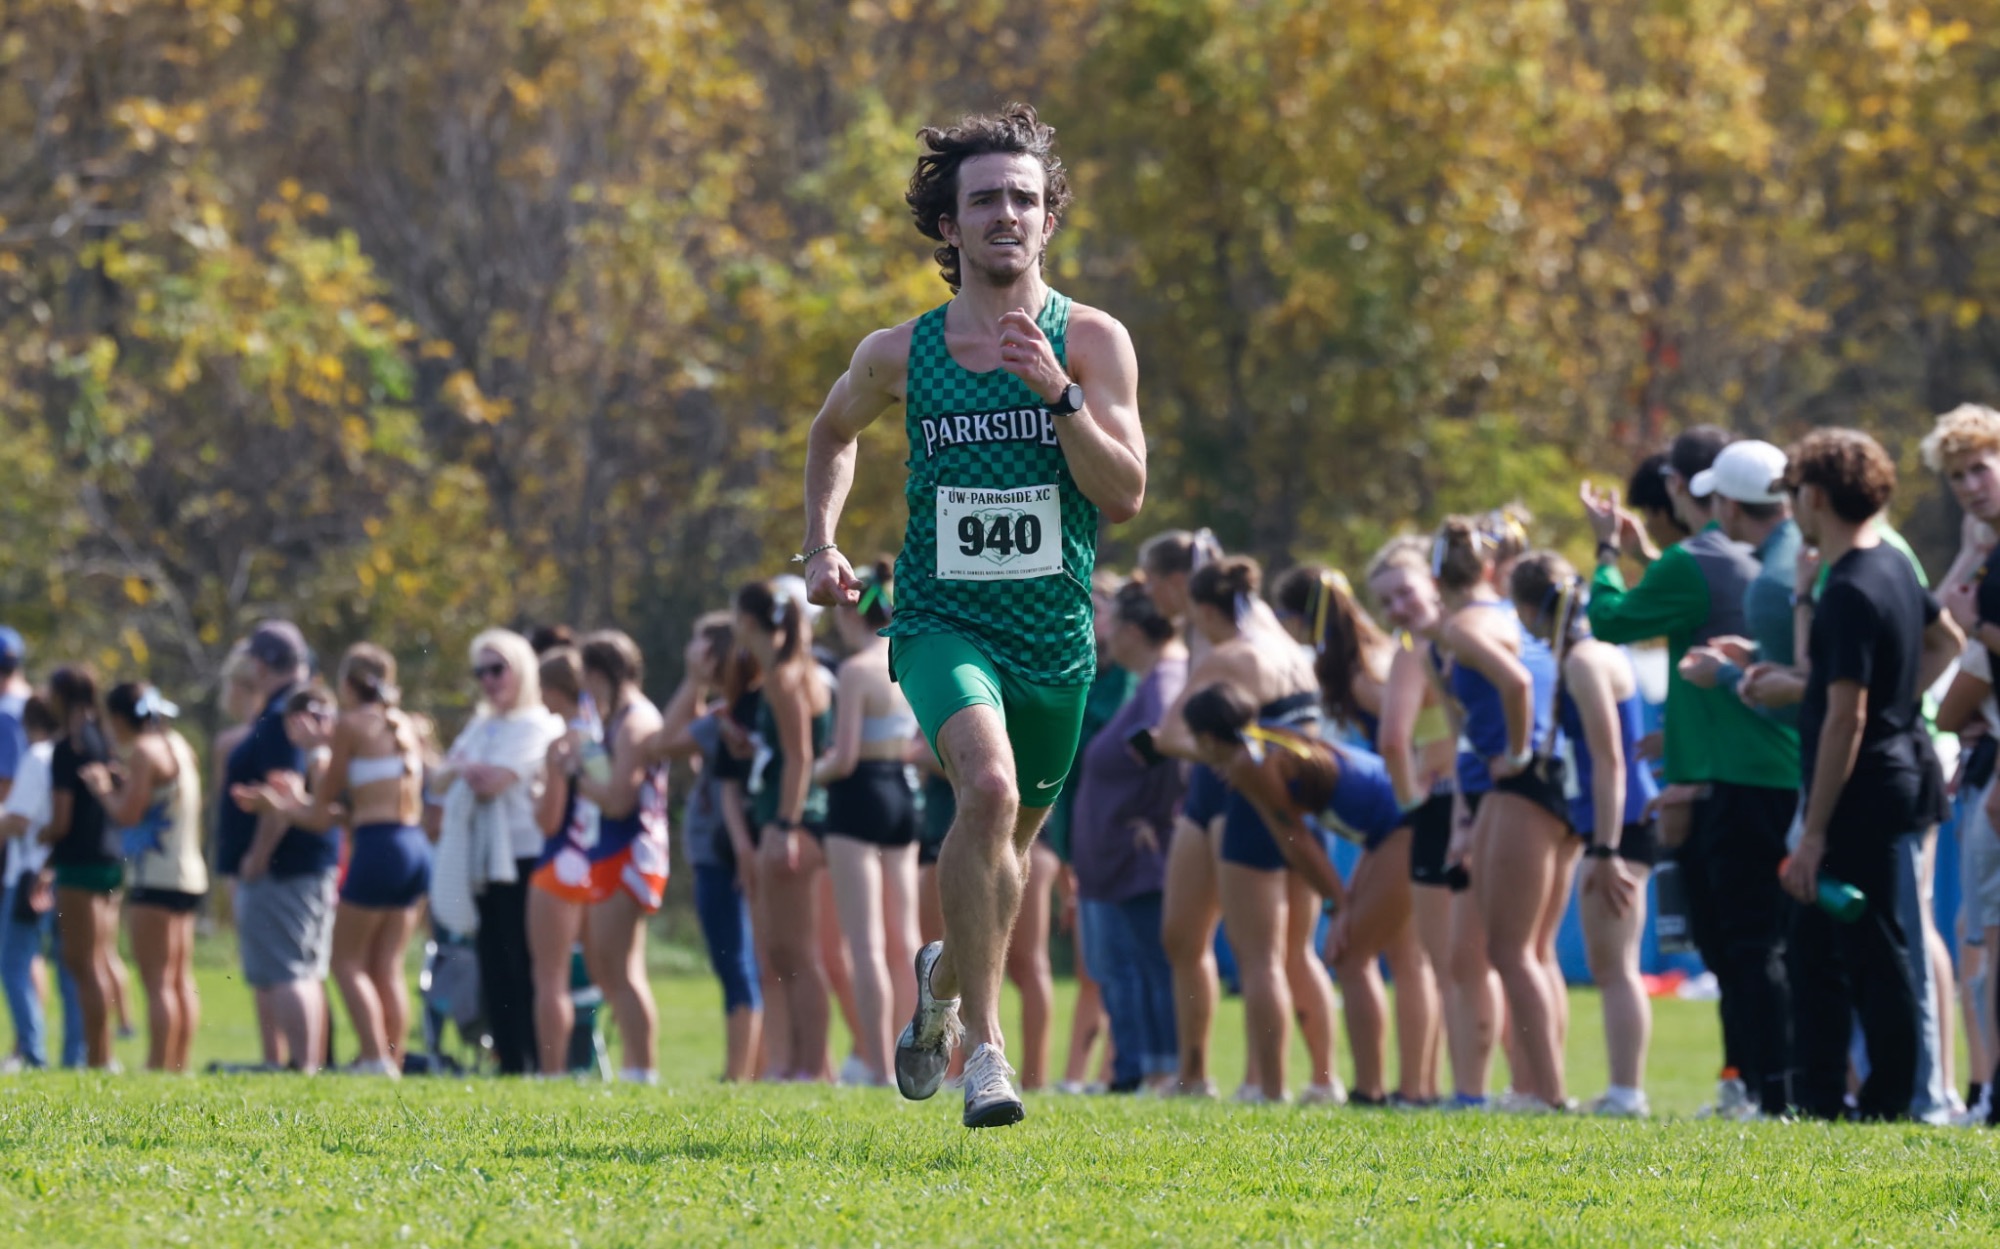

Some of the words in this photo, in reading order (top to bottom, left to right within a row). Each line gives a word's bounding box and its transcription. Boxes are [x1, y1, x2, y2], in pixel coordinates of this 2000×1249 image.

[921, 408, 1057, 457] PARKSIDE
[948, 490, 1032, 505] UW-PARKSIDE
[1035, 488, 1050, 502] XC
[958, 514, 1042, 556] 940
